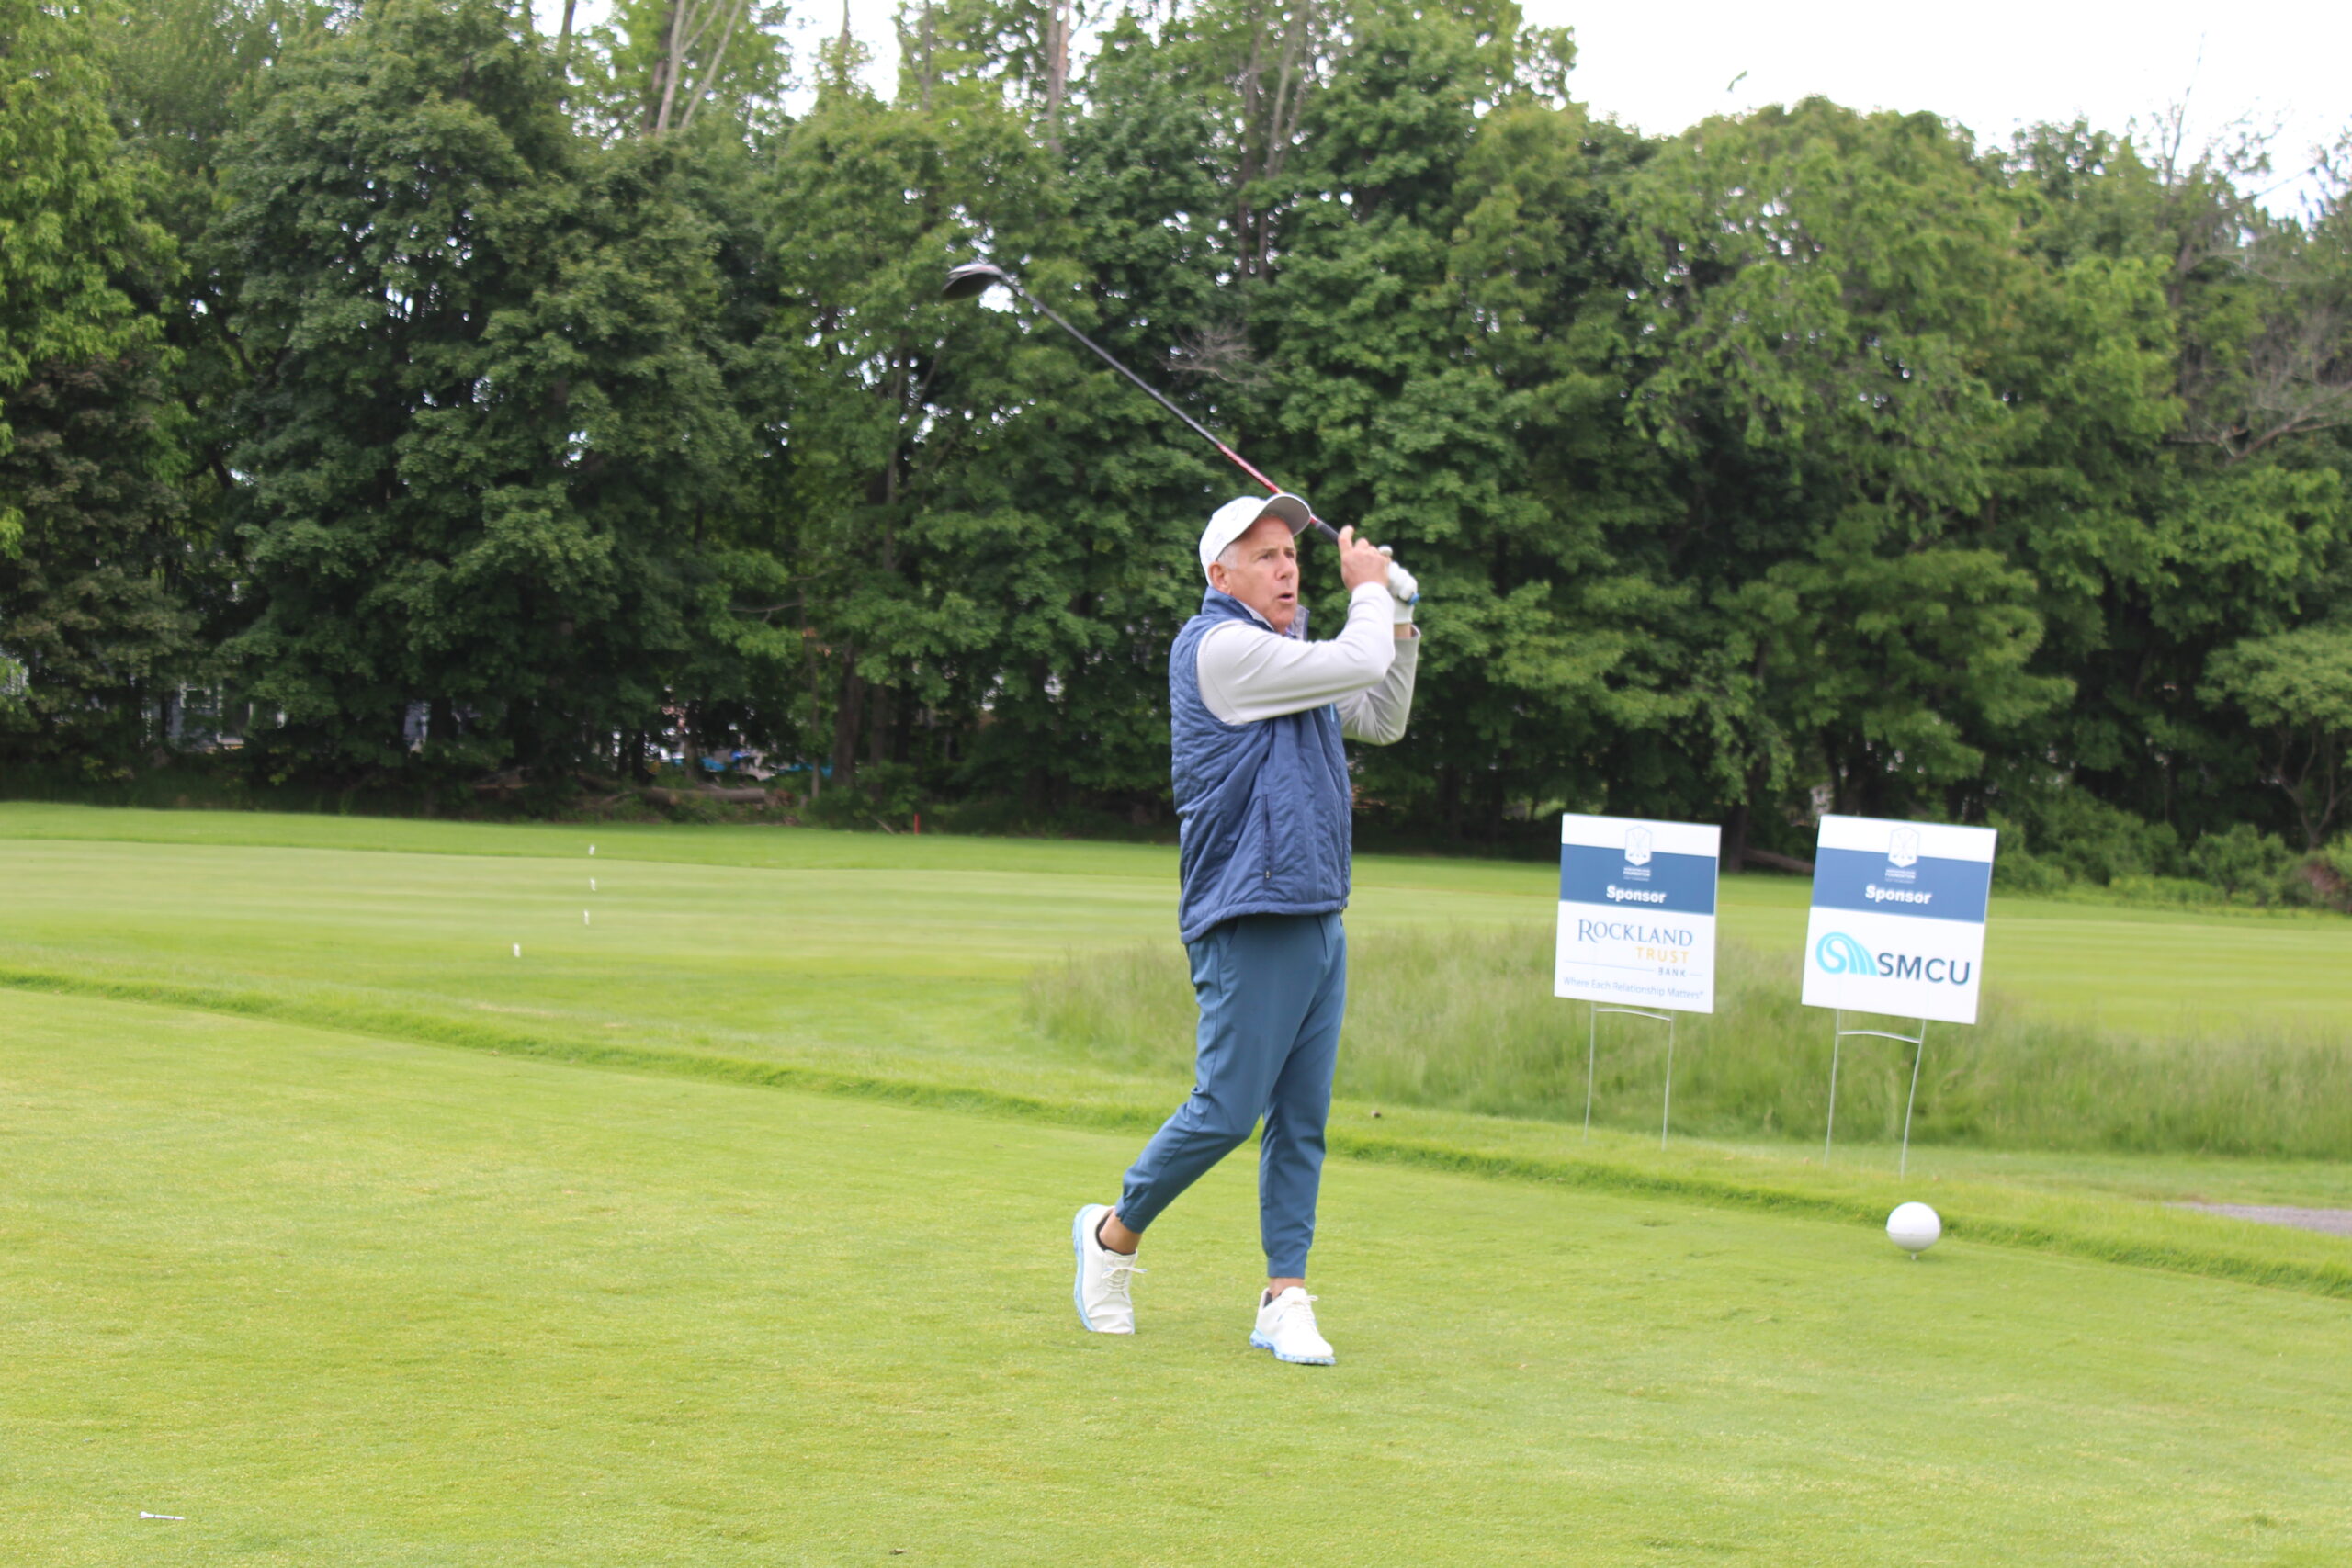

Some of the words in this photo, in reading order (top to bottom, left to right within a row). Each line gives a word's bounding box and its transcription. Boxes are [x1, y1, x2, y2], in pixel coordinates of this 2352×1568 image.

[1606, 885, 1667, 903] Sponsor
[1865, 885, 1932, 904] Sponsor
[1635, 946, 1690, 964] TRUST
[1657, 966, 1687, 977] BANK
[1877, 952, 1971, 987] SMCU
[1564, 976, 1589, 988] Where
[1591, 978, 1611, 990] Each
[1612, 982, 1666, 997] Relationship
